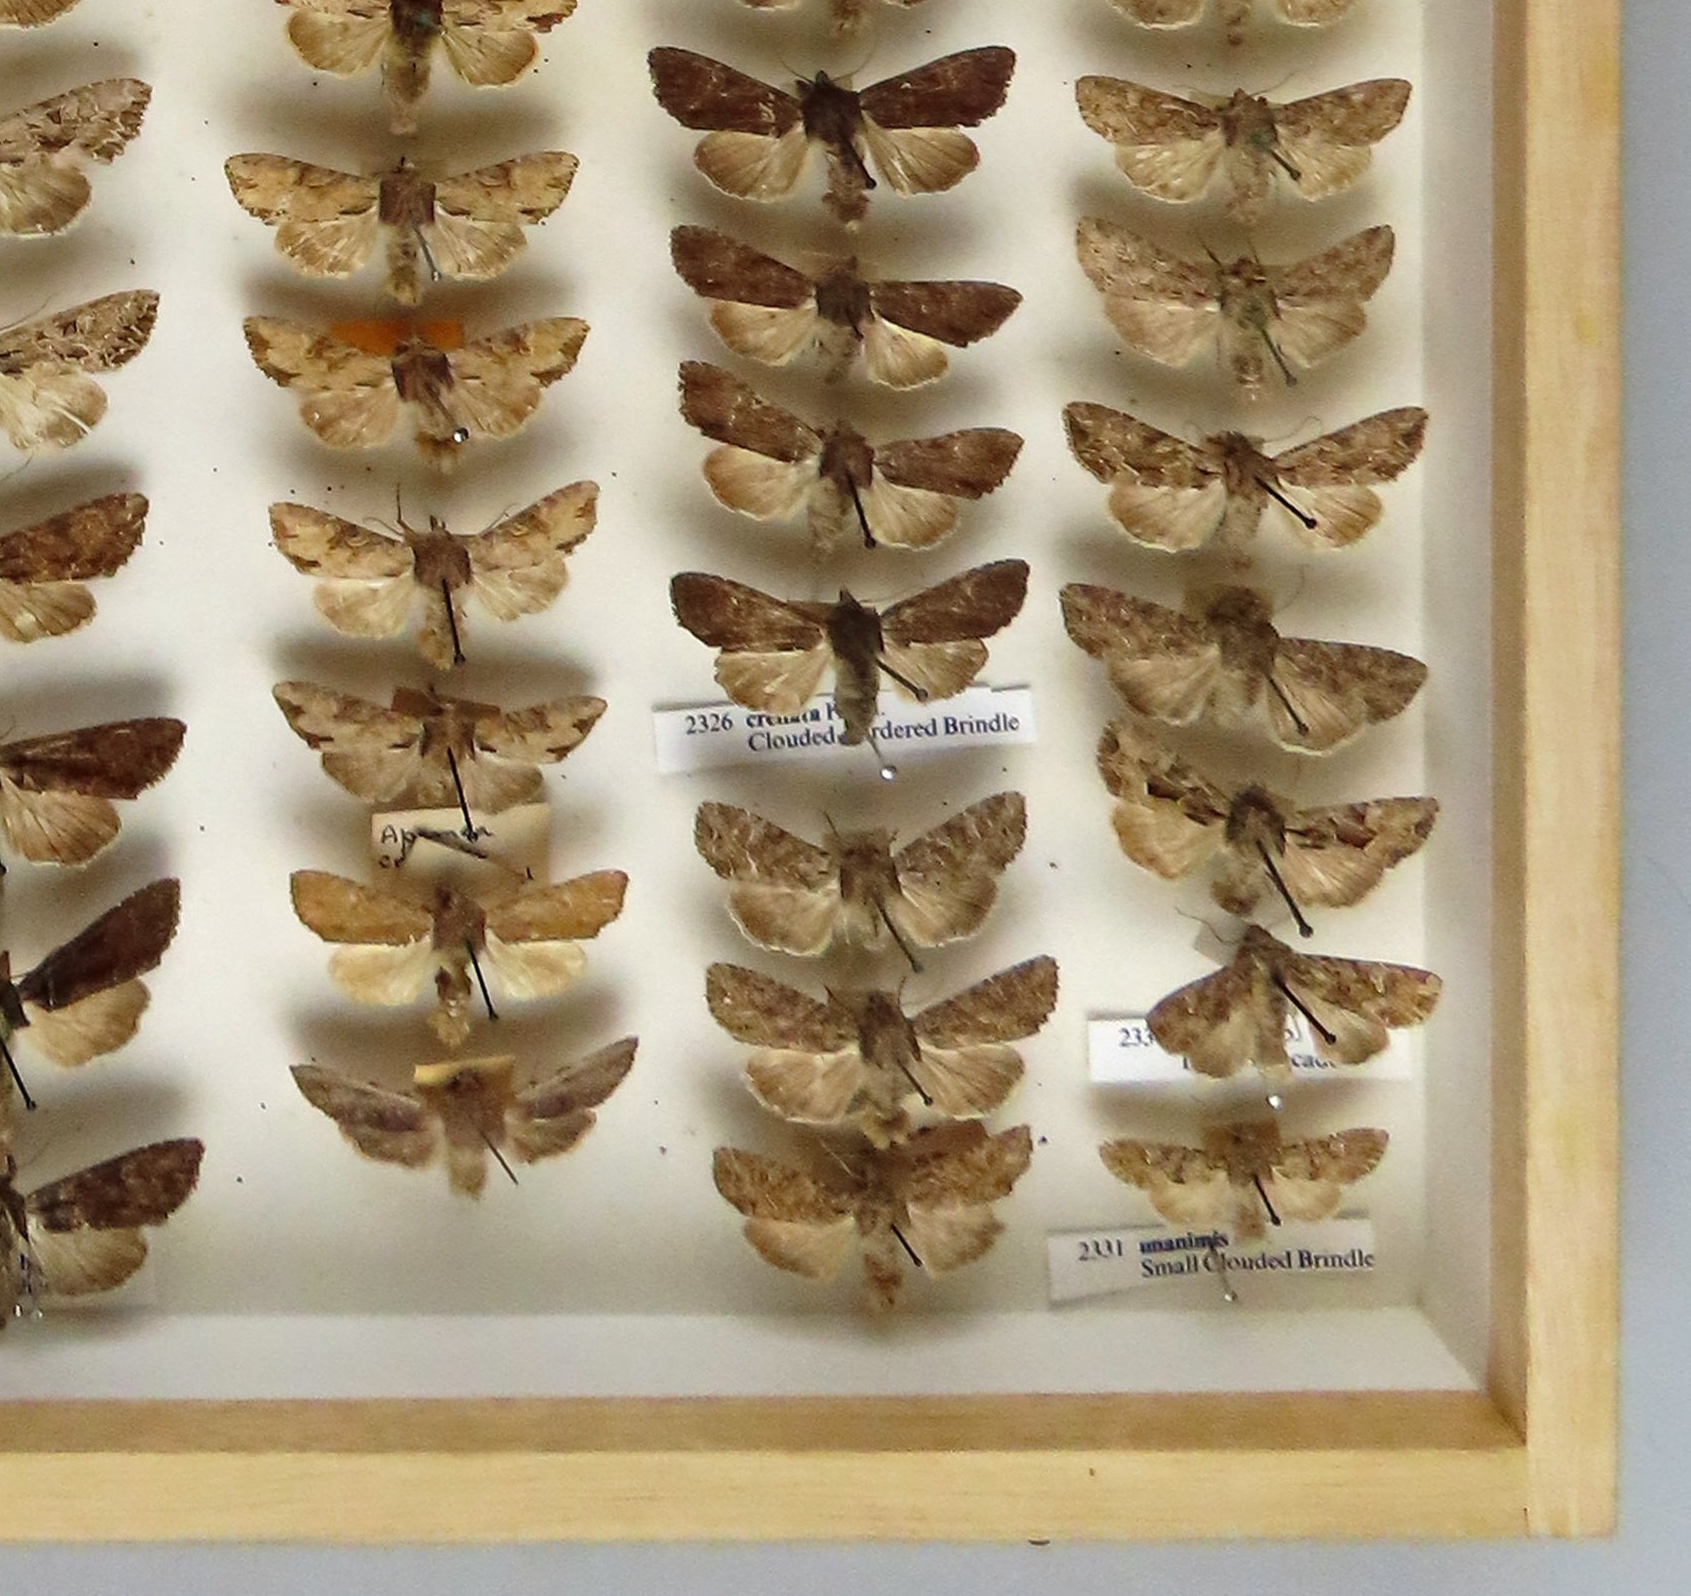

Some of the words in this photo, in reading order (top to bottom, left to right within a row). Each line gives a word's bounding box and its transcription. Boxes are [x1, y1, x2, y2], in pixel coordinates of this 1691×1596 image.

[685, 715, 733, 736] 2326
[944, 712, 1020, 736] Brindle
[1141, 1255, 1198, 1278] Small
[1298, 1247, 1375, 1269] Brindle
